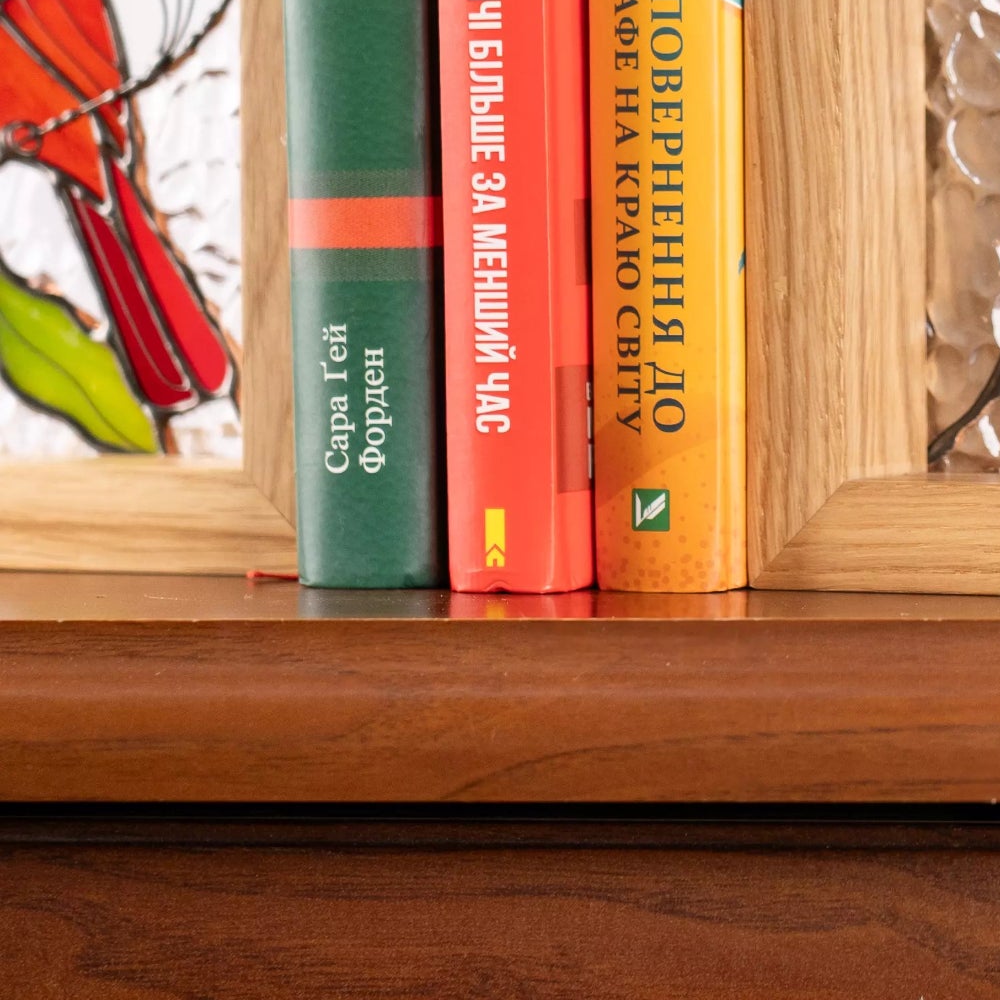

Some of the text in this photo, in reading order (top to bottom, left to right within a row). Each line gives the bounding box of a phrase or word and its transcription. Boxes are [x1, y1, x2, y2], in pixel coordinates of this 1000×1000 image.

[468, 39, 506, 163] БІЛЬШЕ
[614, 85, 640, 148] НА
[471, 172, 507, 214] ЗА
[615, 161, 641, 291] КРАЮ
[472, 223, 517, 363] МЕНШИЙ
[319, 323, 356, 474] Сара Ґей
[358, 346, 393, 474] Форден
[475, 372, 511, 434] ЧАС
[615, 304, 642, 436] СВІТУ
[643, 361, 687, 433] ДО
